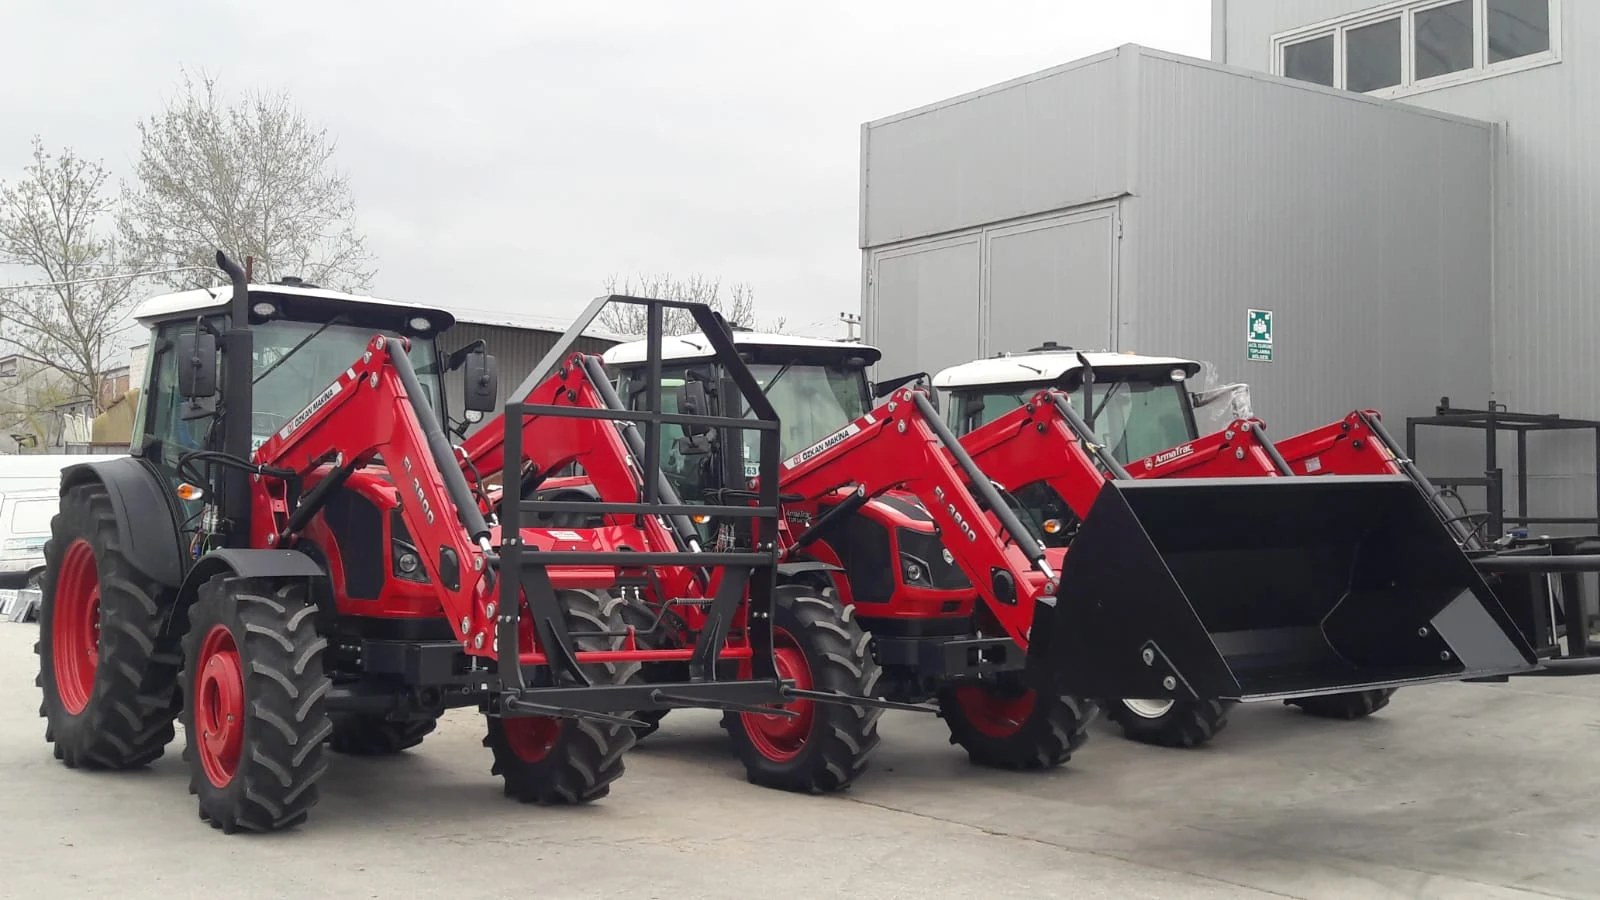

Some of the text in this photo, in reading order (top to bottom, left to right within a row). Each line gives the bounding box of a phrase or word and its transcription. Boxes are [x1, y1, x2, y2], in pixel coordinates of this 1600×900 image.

[1155, 444, 1193, 465] ArmaTrac
[744, 466, 757, 475] 63
[948, 503, 976, 542] 3800
